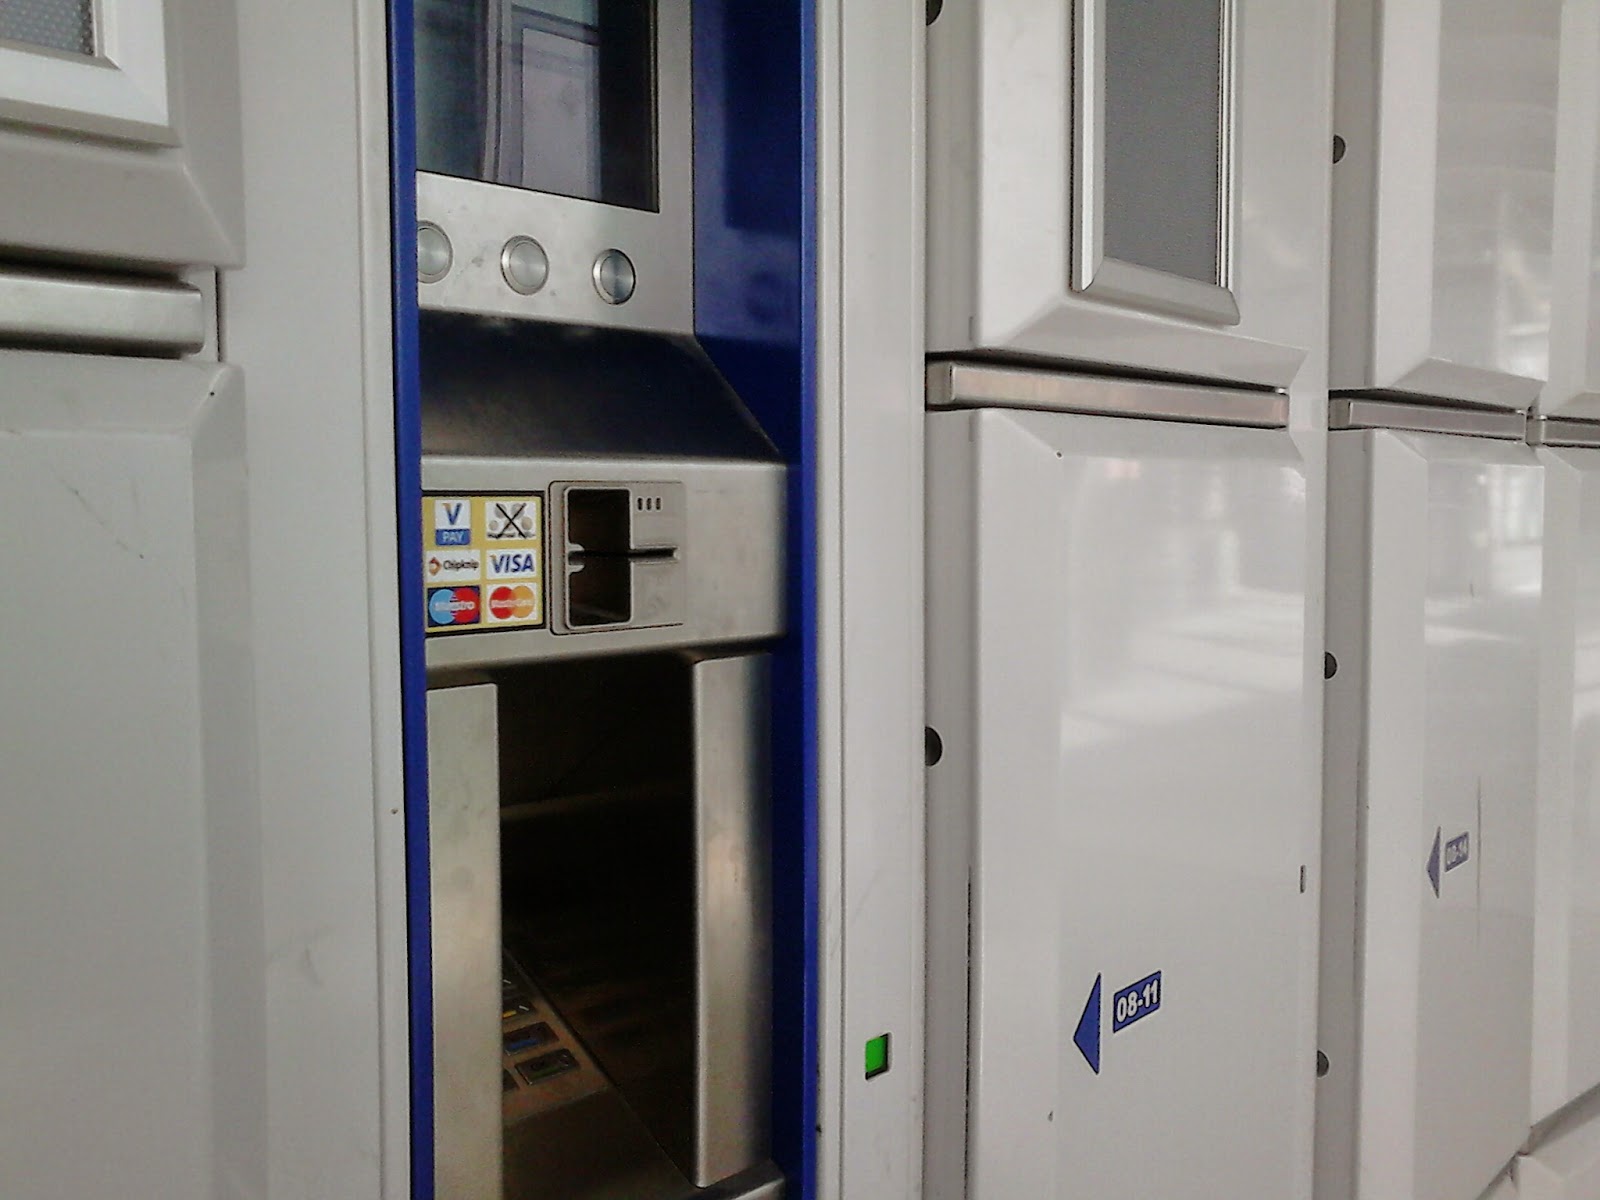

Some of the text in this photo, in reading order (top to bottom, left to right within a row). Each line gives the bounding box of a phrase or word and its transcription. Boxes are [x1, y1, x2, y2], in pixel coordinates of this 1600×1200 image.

[442, 503, 463, 525] V
[442, 531, 464, 543] PAY
[489, 553, 535, 574] VISA
[1116, 979, 1159, 1023] 08-11
